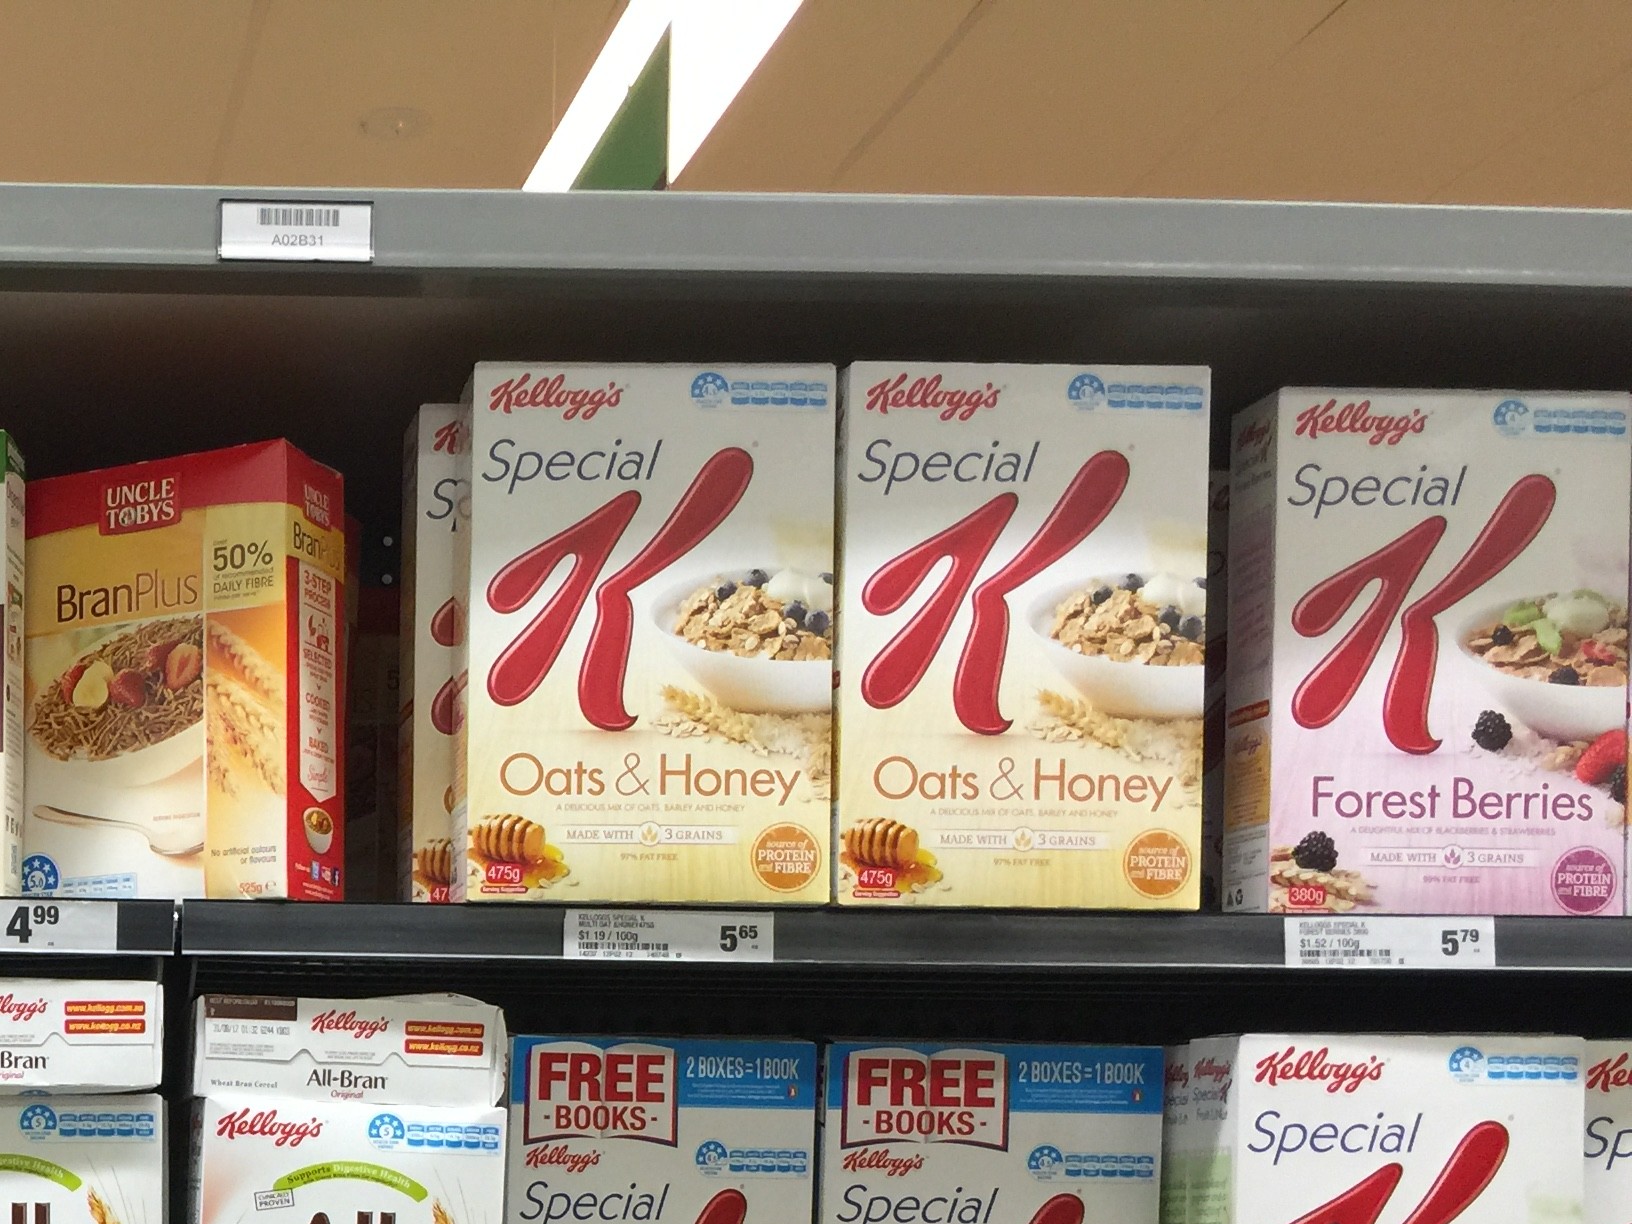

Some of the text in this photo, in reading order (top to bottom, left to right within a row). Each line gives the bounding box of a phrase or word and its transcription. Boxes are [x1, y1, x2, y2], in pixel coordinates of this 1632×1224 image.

[271, 234, 324, 247] A02B31
[488, 373, 623, 420] Kellogg's
[481, 438, 662, 490] Special
[106, 479, 176, 504] UNCLE
[106, 501, 176, 525] TOBYS
[212, 542, 273, 572] 50%
[57, 572, 199, 623] BranPlus
[213, 575, 274, 592] DAILY FIBRE
[499, 751, 801, 806] Oats & Honey
[1311, 776, 1594, 822] Forest Berries
[567, 828, 599, 840] MADE
[603, 828, 633, 840] WITH
[239, 881, 263, 894] 525g
[1290, 888, 1324, 904] 380g
[537, 1051, 665, 1104] FREE
[1247, 1113, 1425, 1165] Special
